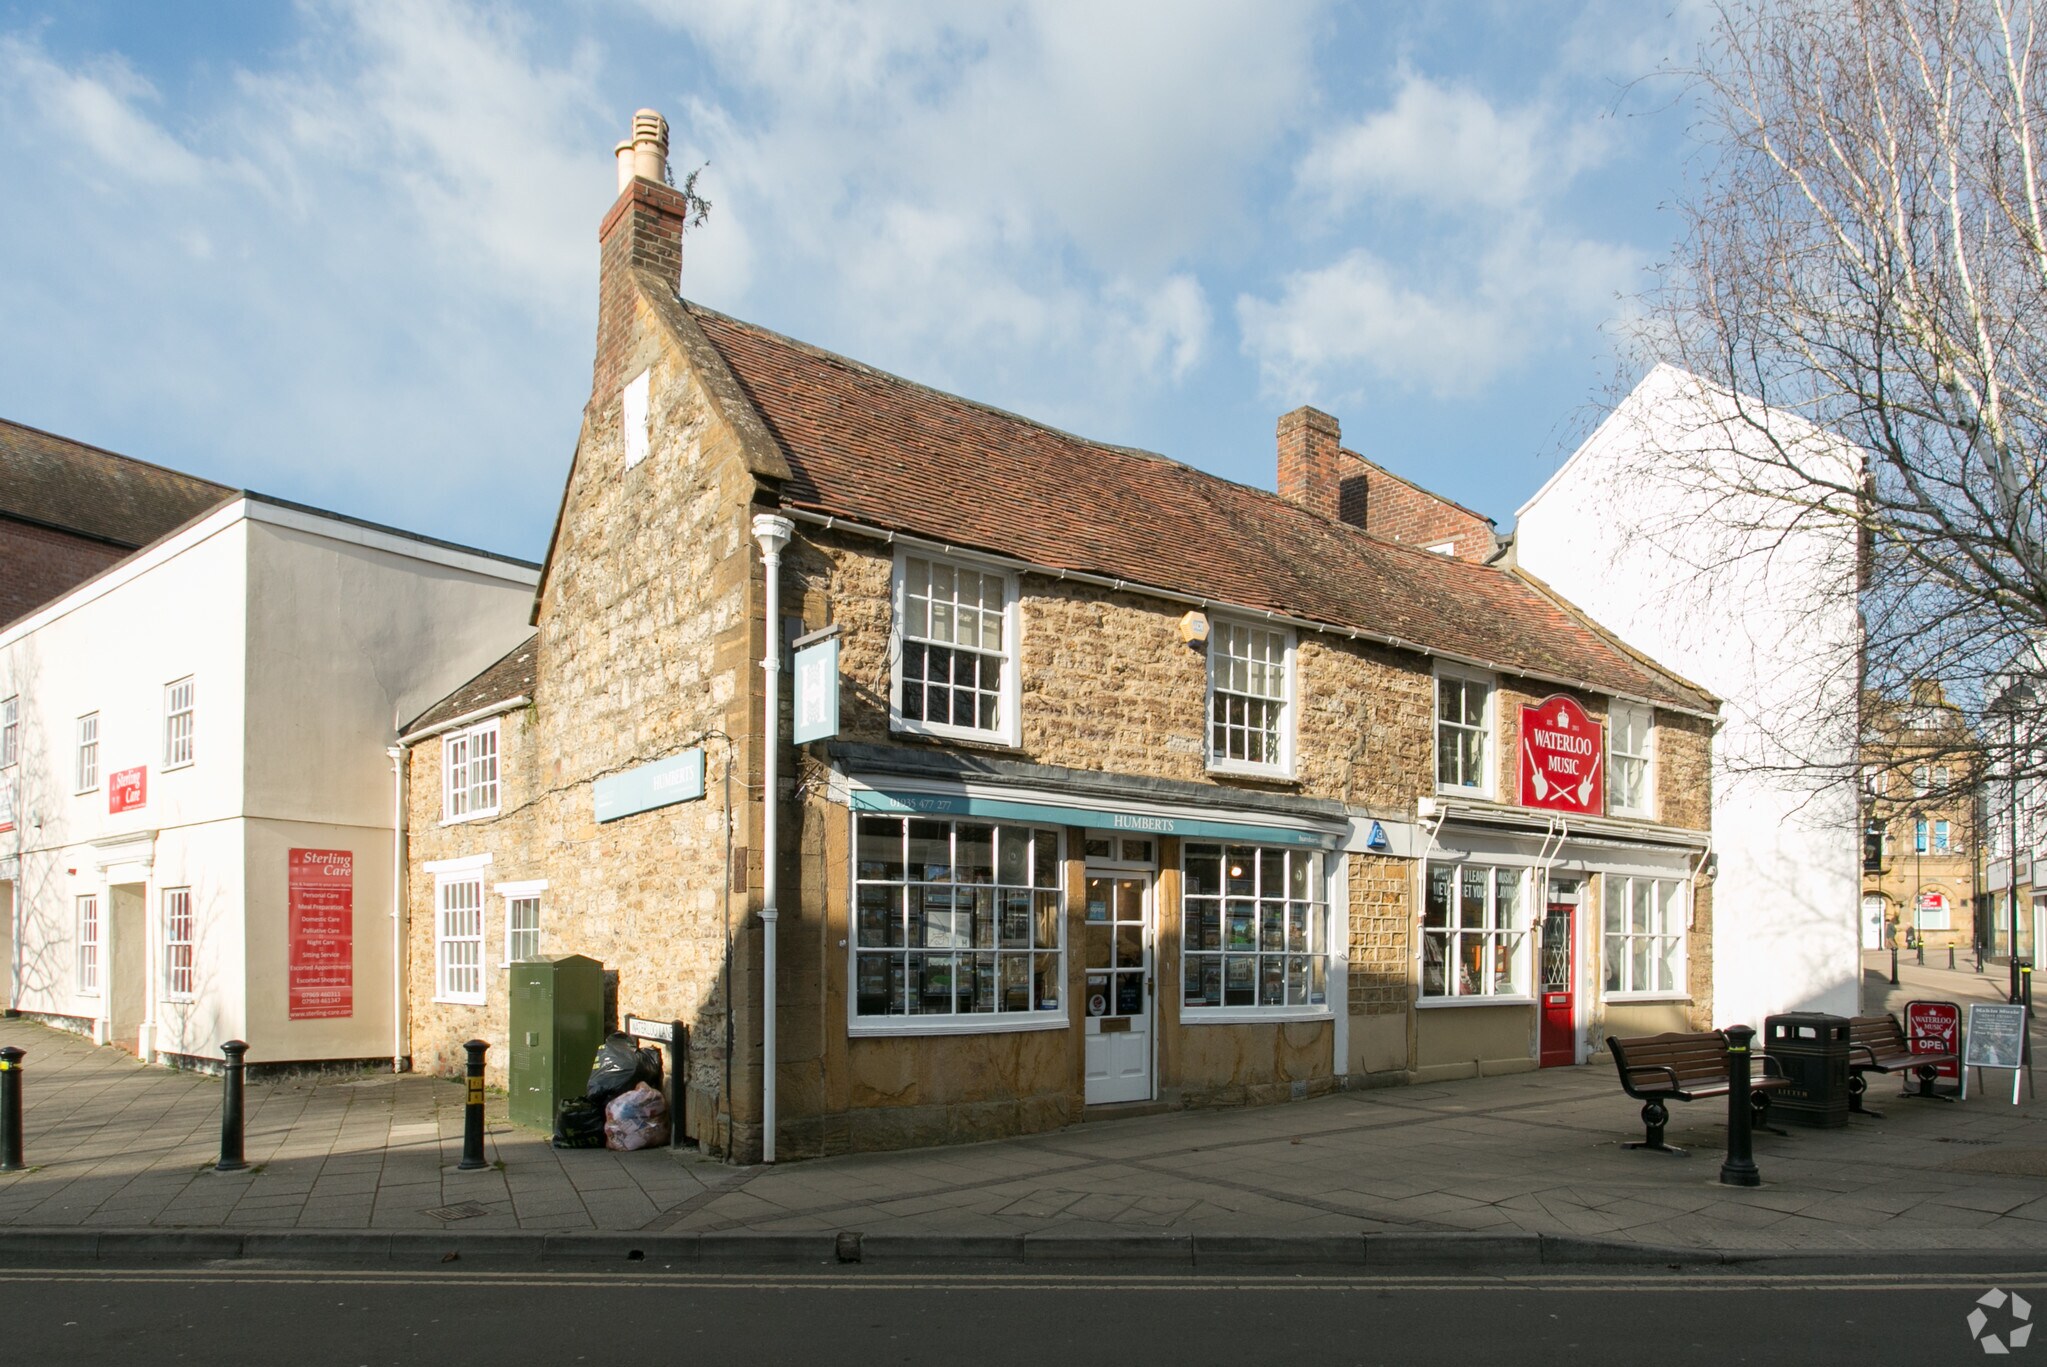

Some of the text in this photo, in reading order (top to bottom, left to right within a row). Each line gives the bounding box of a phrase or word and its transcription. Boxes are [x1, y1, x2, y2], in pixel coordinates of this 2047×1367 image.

[1534, 728, 1592, 756] WATERLOO
[1548, 755, 1579, 775] MUSIC
[653, 765, 695, 791] HUMBERTS
[890, 798, 952, 810] 01935 477 277
[1114, 815, 1174, 832] HUMBERTS
[304, 852, 351, 868] Sterling
[323, 865, 351, 876] Care
[1915, 1016, 1952, 1024] WATERLOO
[631, 1021, 659, 1037] WATERLOO
